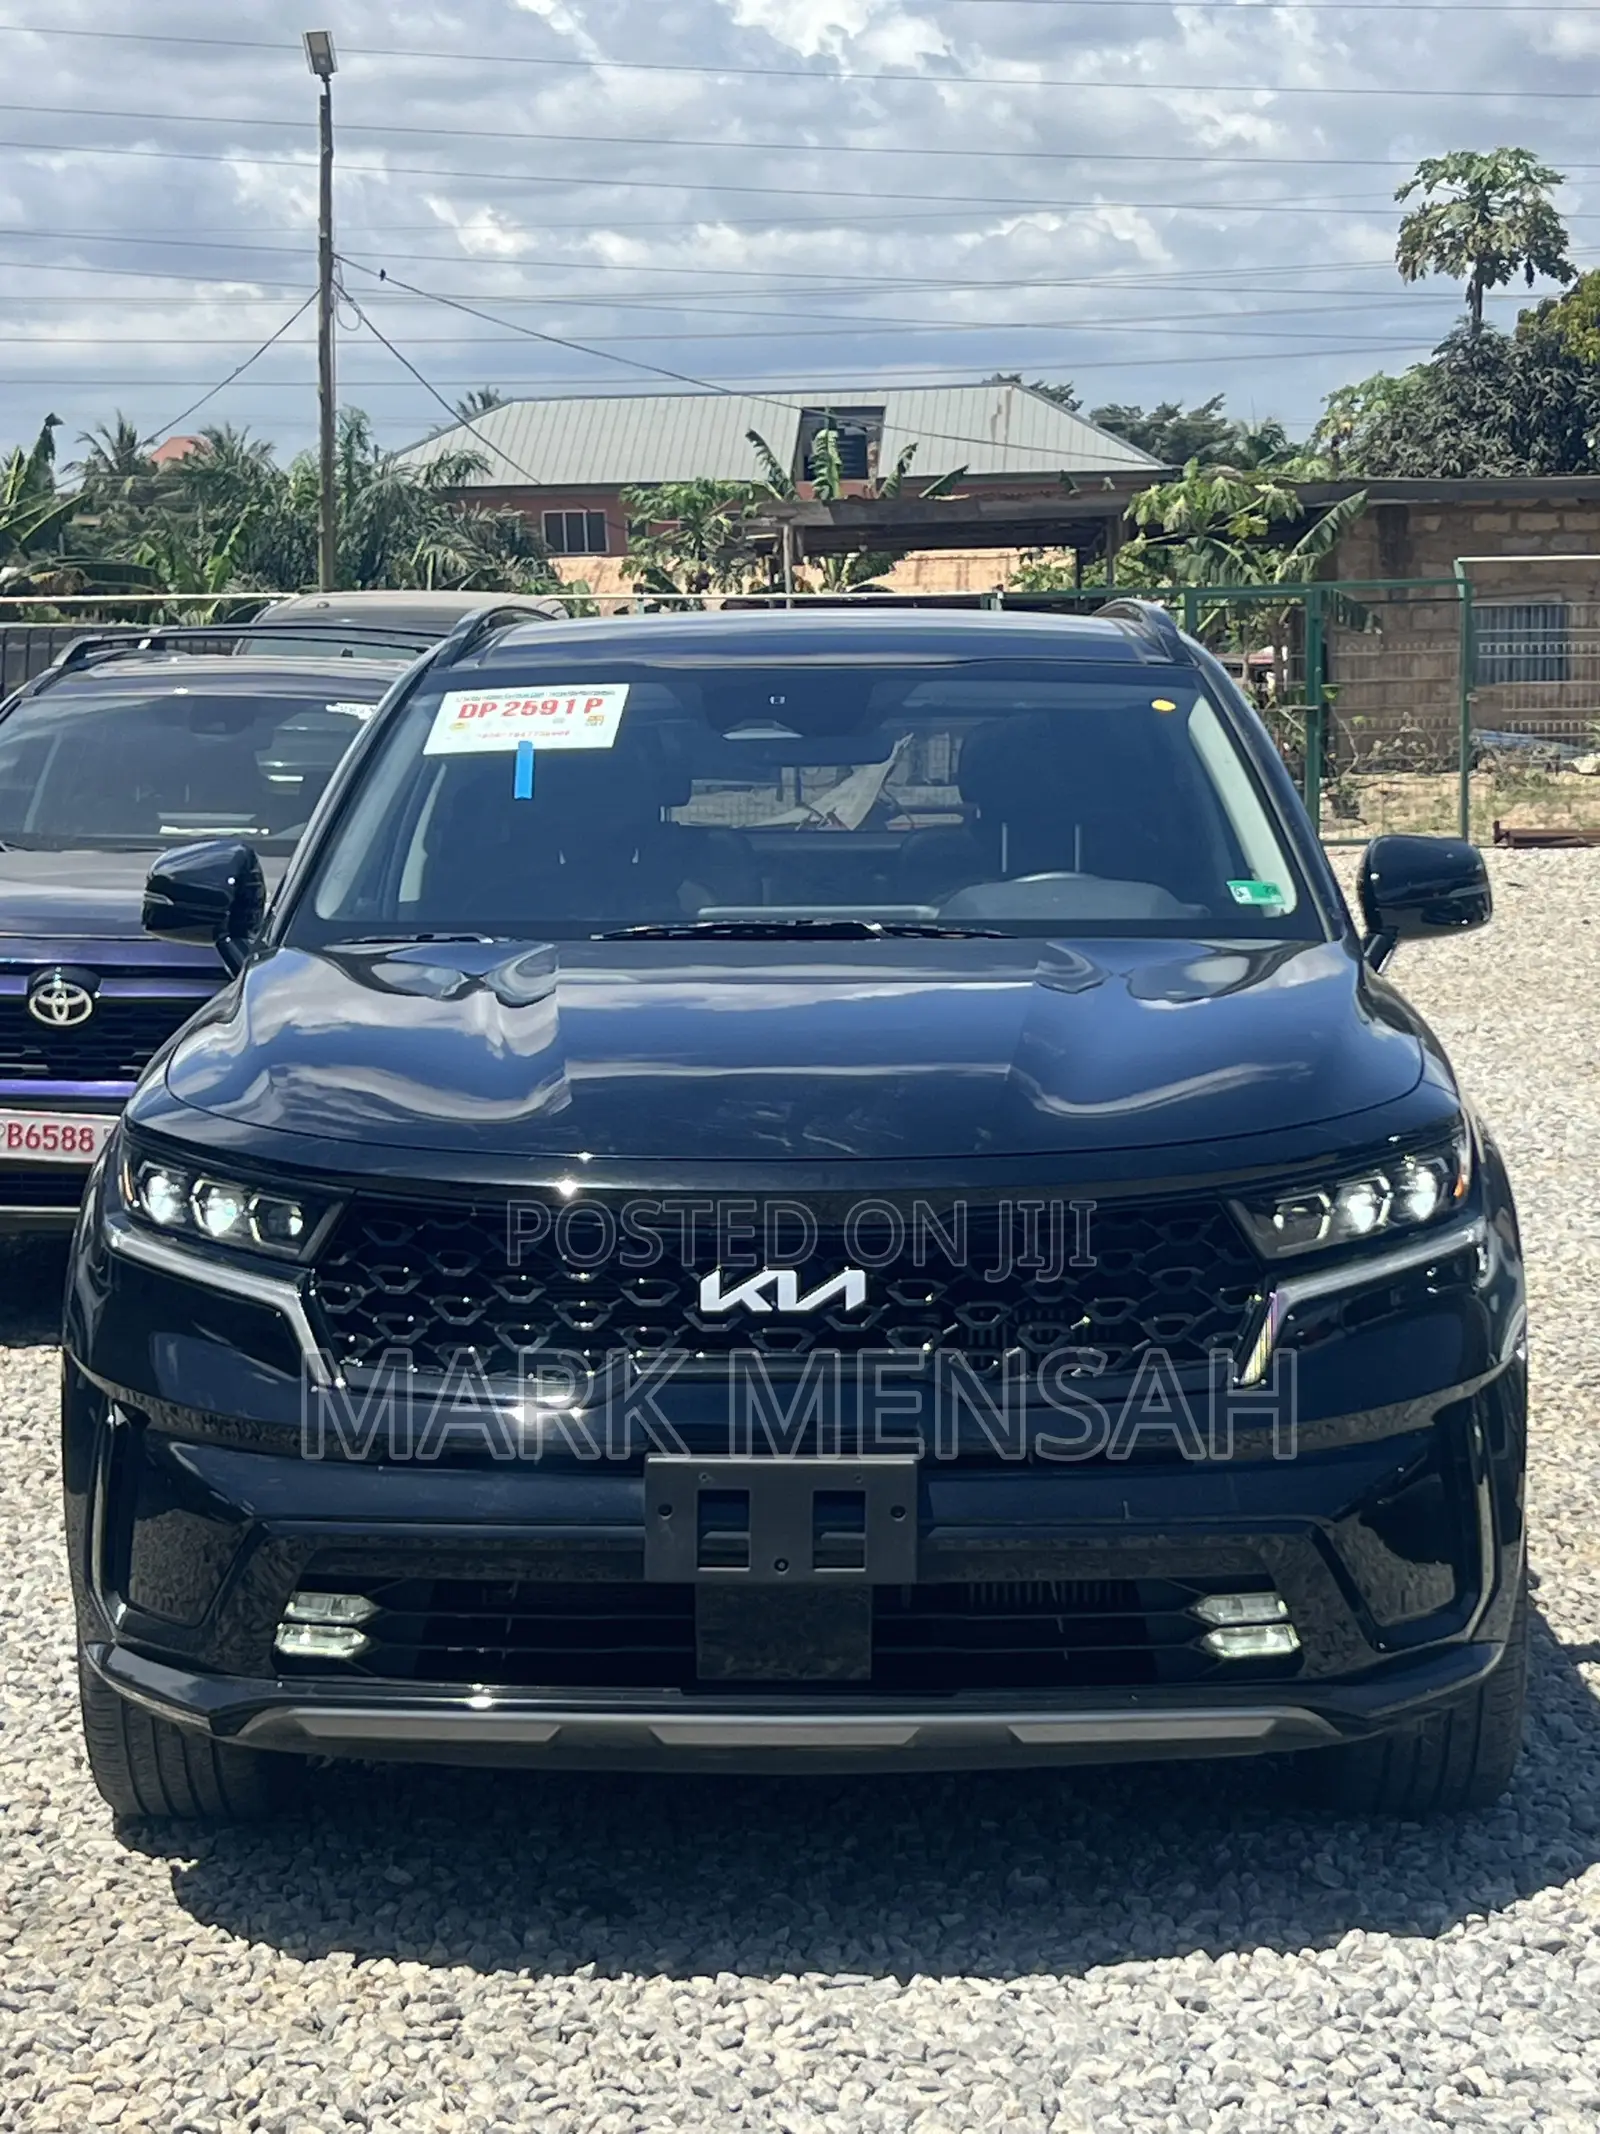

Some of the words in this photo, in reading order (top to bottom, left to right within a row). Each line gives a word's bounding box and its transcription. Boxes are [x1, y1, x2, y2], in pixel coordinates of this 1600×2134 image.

[458, 703, 498, 719] DP
[501, 699, 576, 717] 2591
[584, 697, 604, 714] P
[7, 1122, 94, 1152] B6588
